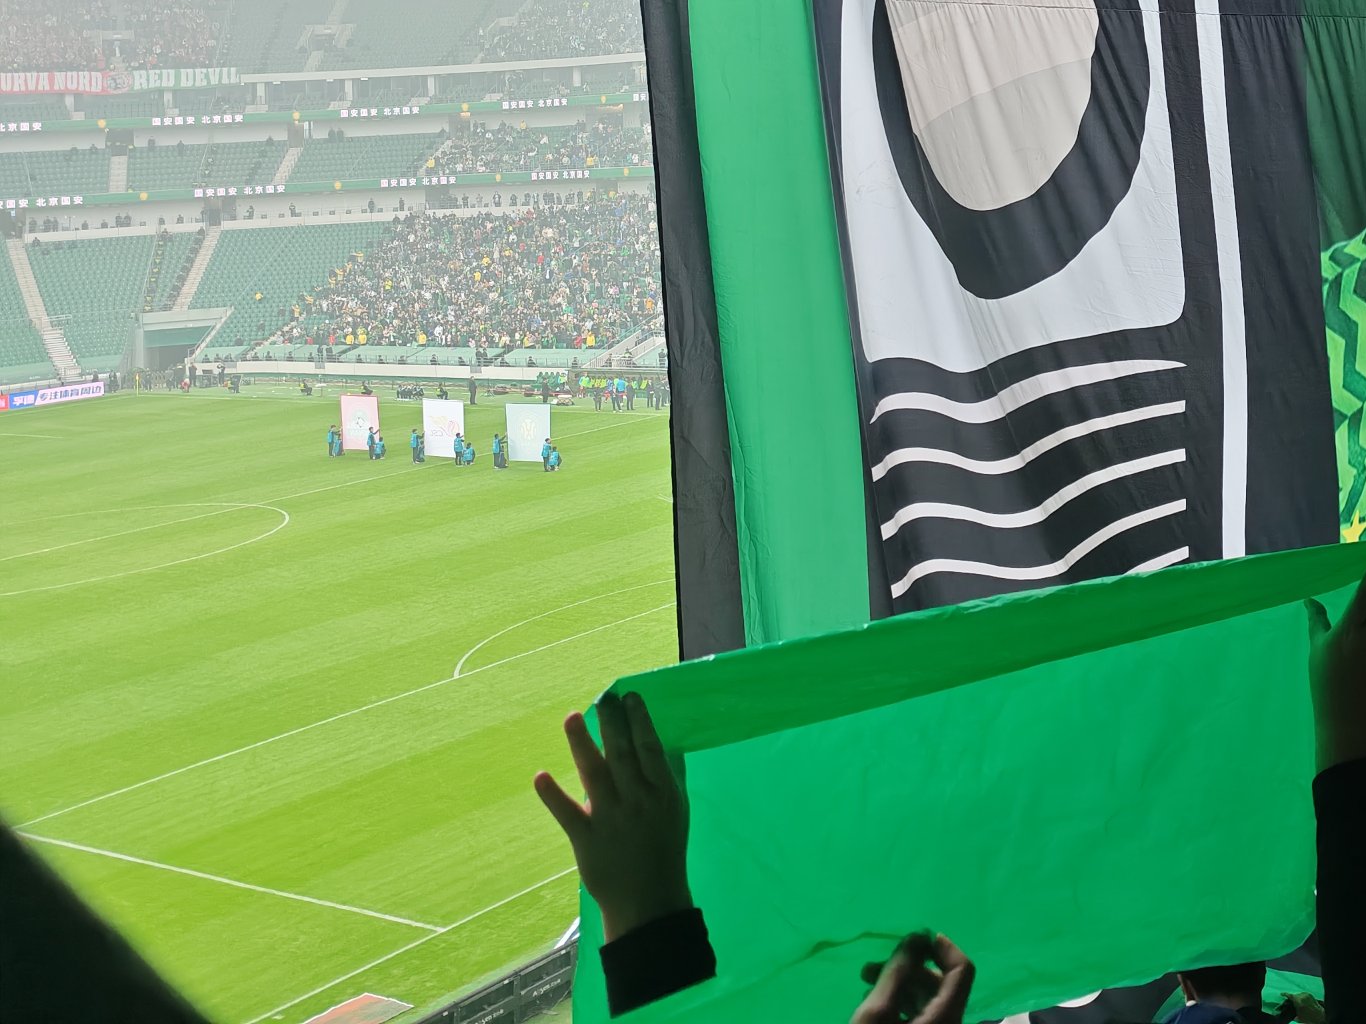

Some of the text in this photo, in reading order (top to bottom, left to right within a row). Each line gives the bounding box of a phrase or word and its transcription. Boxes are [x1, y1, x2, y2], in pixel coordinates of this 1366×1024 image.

[53, 71, 102, 91] NORD
[132, 69, 175, 90] RED
[340, 106, 420, 118] 国安国安 北京国安
[152, 114, 244, 126] 国安国安 北京国安
[194, 184, 286, 198] 国安国安 北京国安
[36, 196, 83, 207] 北京国安
